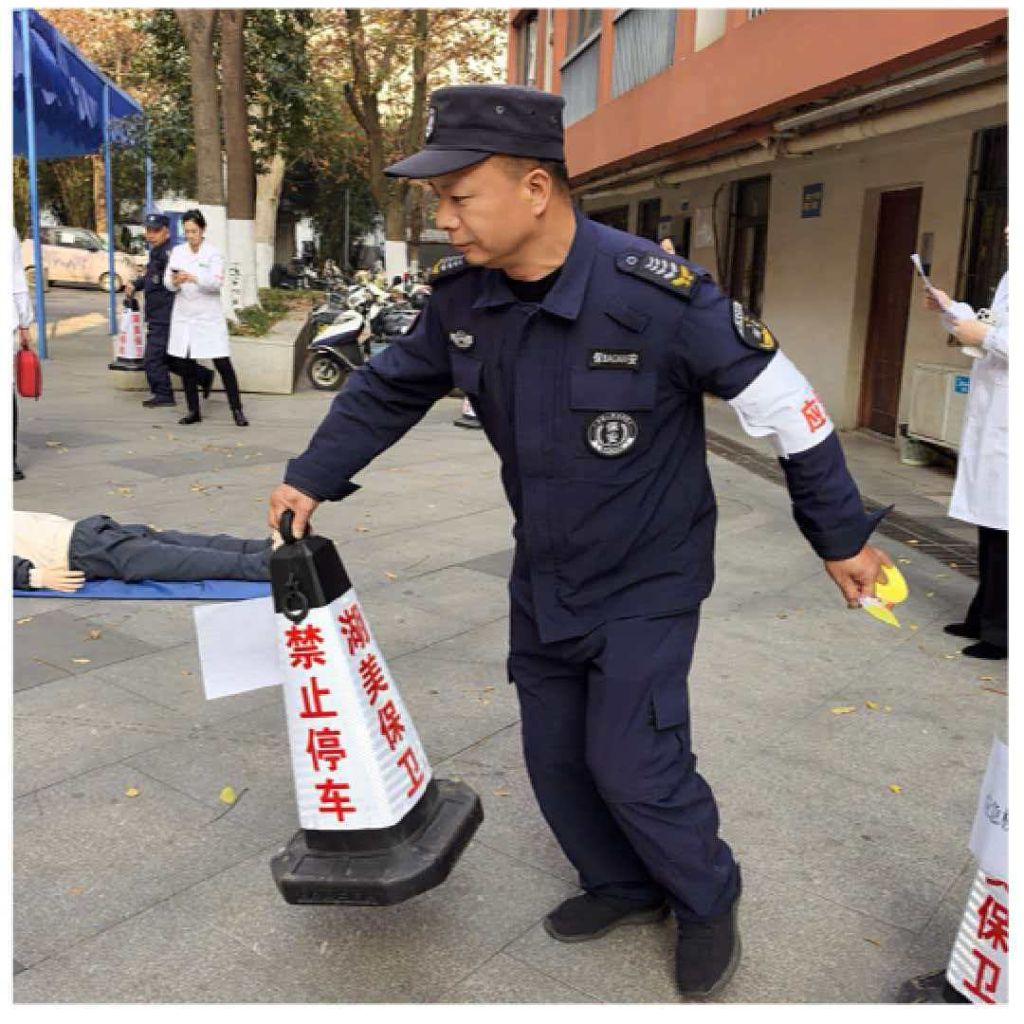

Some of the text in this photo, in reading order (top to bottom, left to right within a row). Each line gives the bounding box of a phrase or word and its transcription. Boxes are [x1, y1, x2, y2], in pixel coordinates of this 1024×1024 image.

[284, 622, 358, 823] 禁止停车
[336, 602, 426, 799] 湖美保卫
[962, 876, 1009, 1005] 保卫
